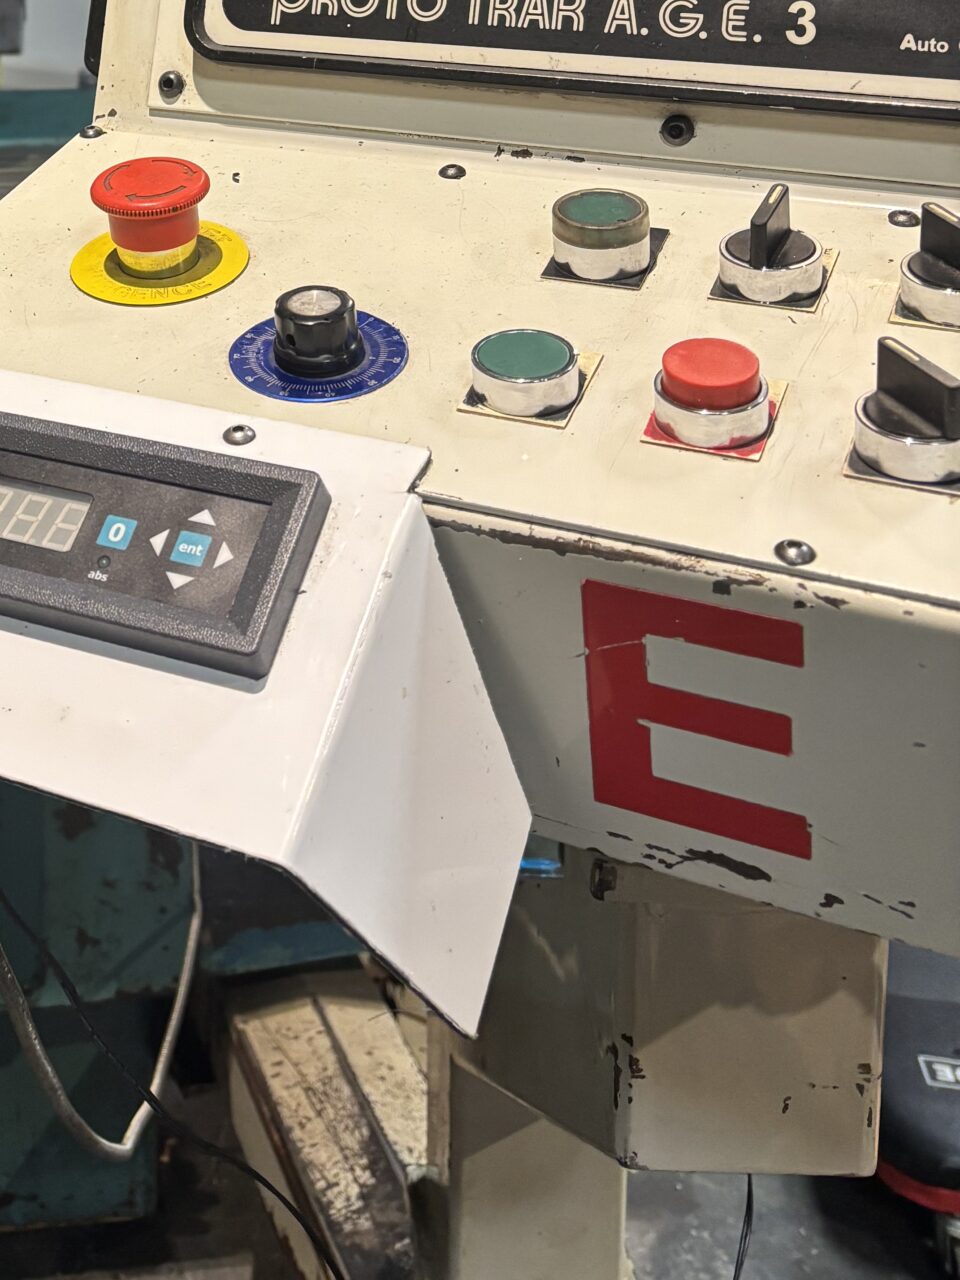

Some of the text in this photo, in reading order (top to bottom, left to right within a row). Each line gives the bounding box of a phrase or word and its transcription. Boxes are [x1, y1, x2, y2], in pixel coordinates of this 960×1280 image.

[784, 0, 818, 45] 3
[899, 33, 949, 53] Auto
[108, 522, 127, 543] 0
[178, 542, 204, 557] ent
[87, 570, 109, 583] abs
[581, 578, 813, 861] E
